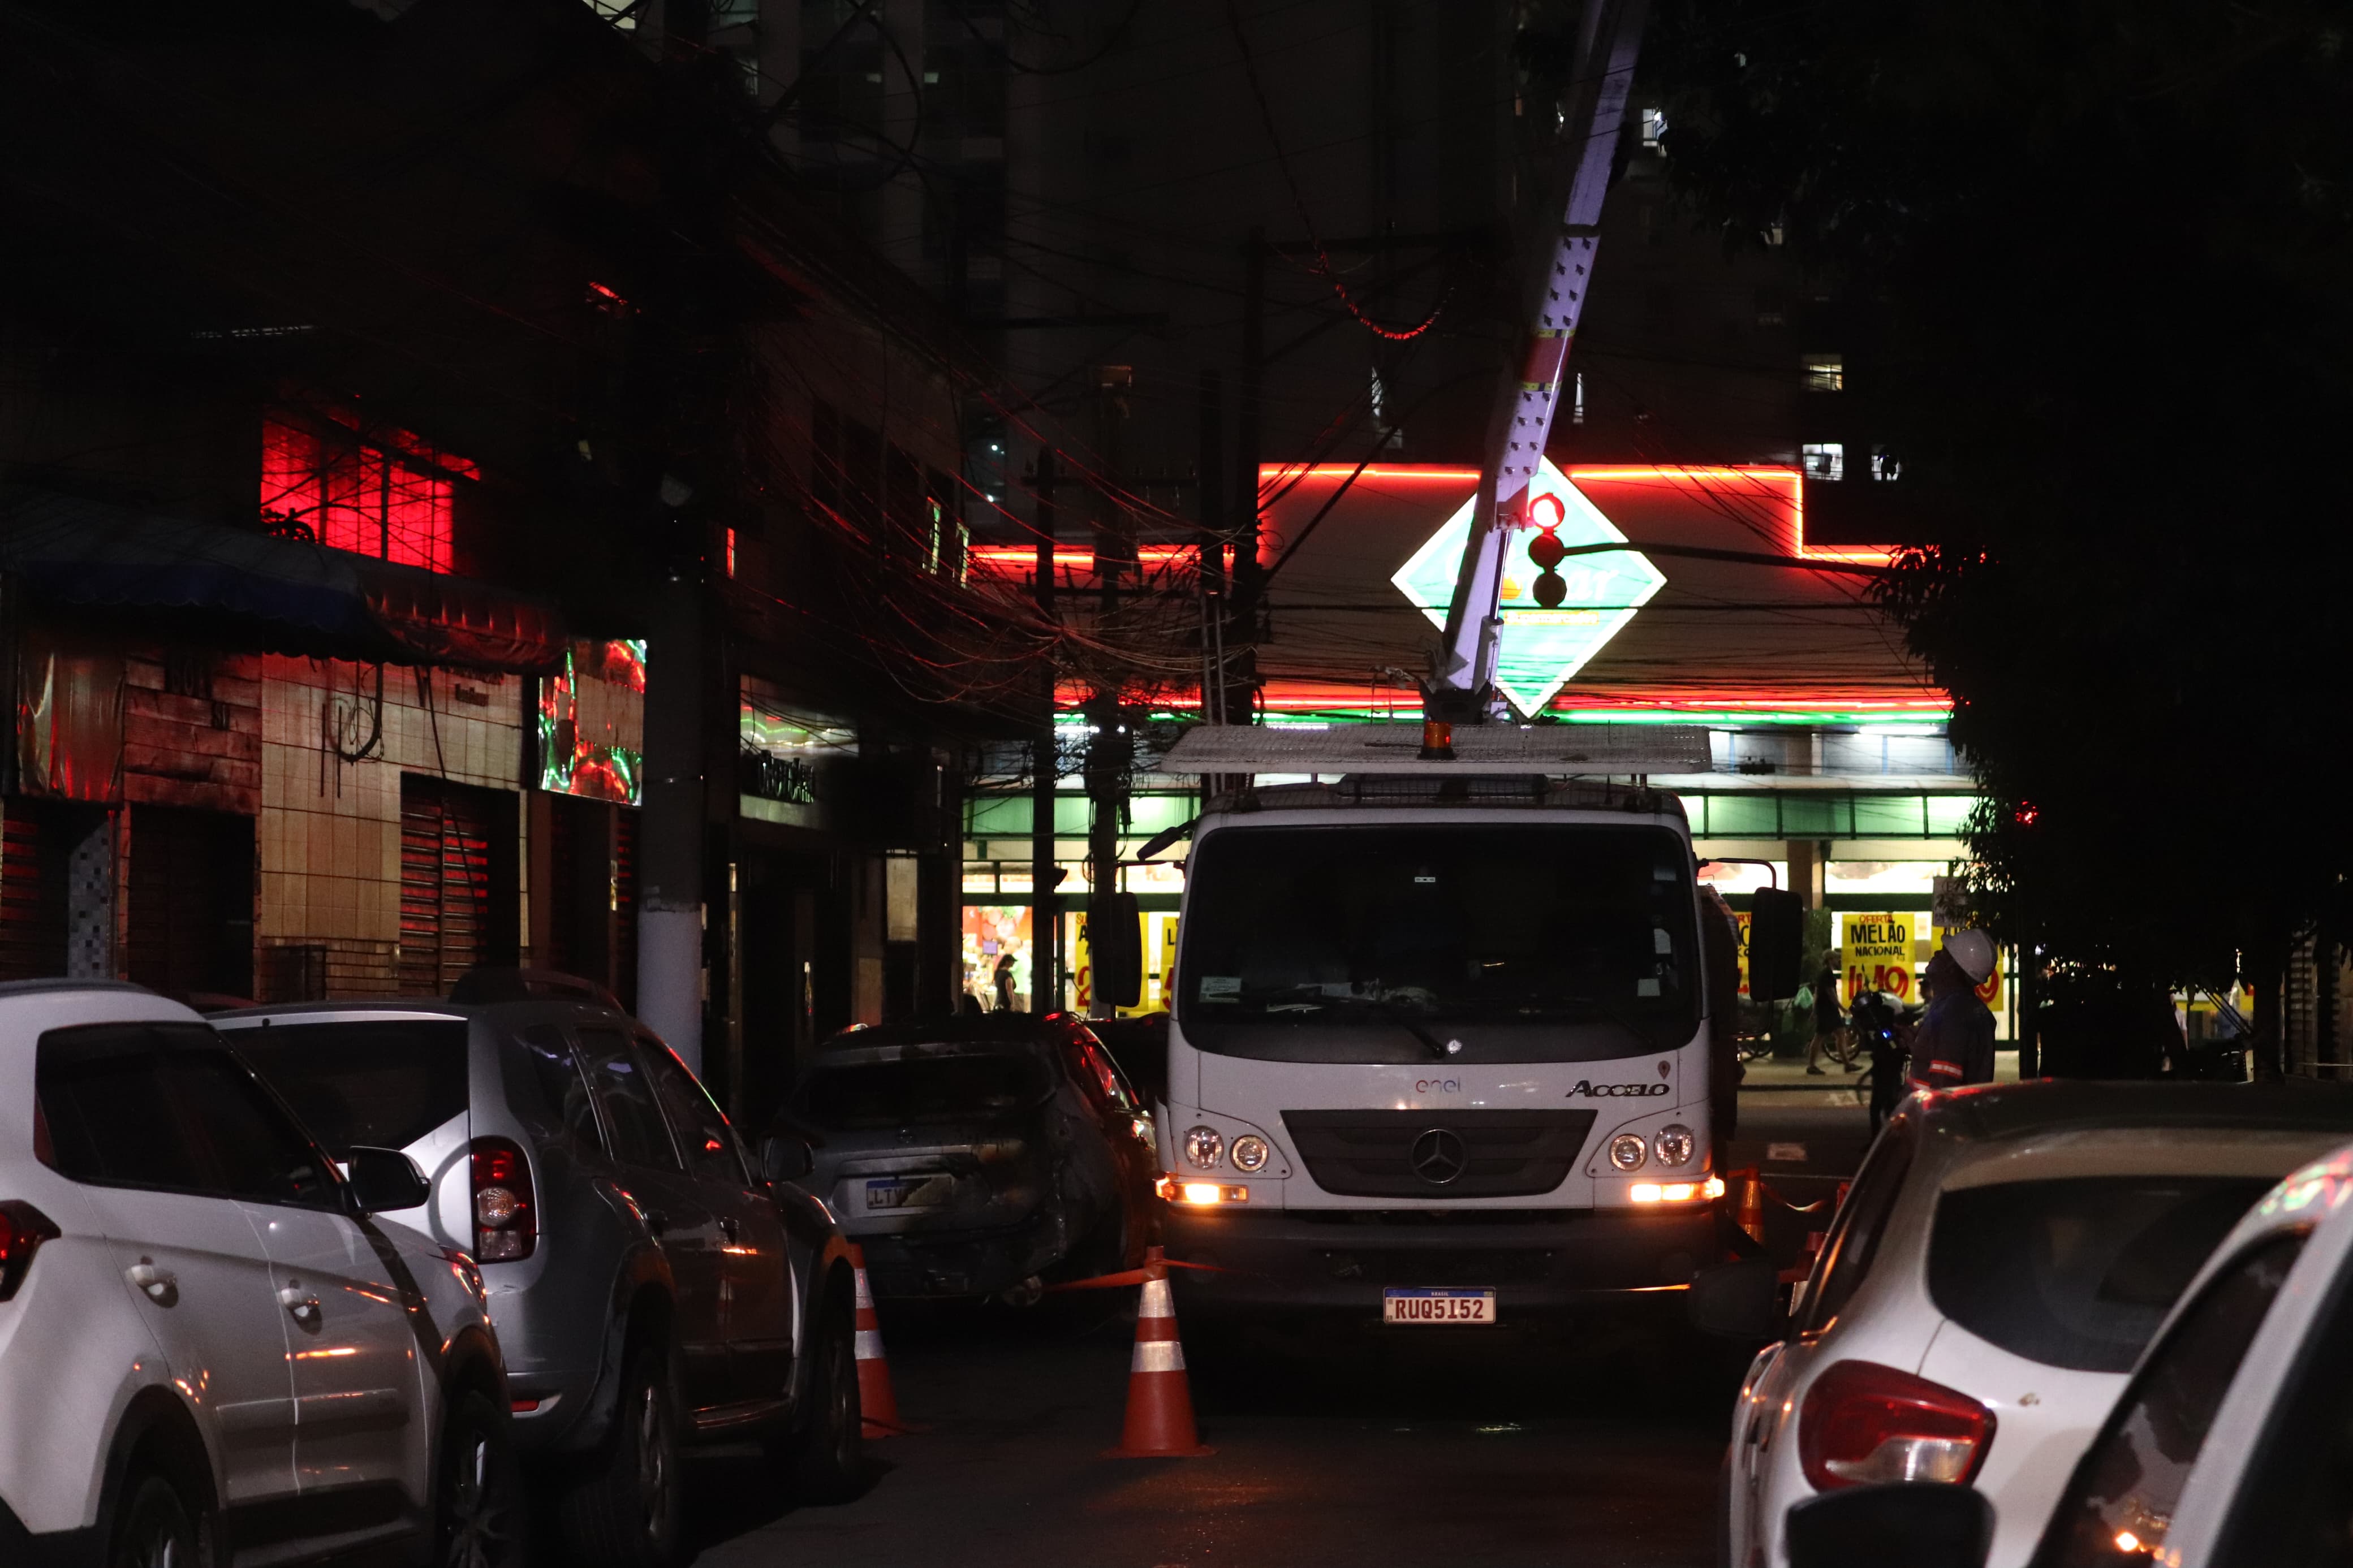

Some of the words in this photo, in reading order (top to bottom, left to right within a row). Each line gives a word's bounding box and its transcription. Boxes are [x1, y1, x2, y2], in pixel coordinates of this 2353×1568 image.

[1859, 915, 1893, 923] OFERTA
[1850, 920, 1906, 944] MELÃO
[1855, 946, 1905, 957] NACIONAL
[1416, 1077, 1460, 1093] enel
